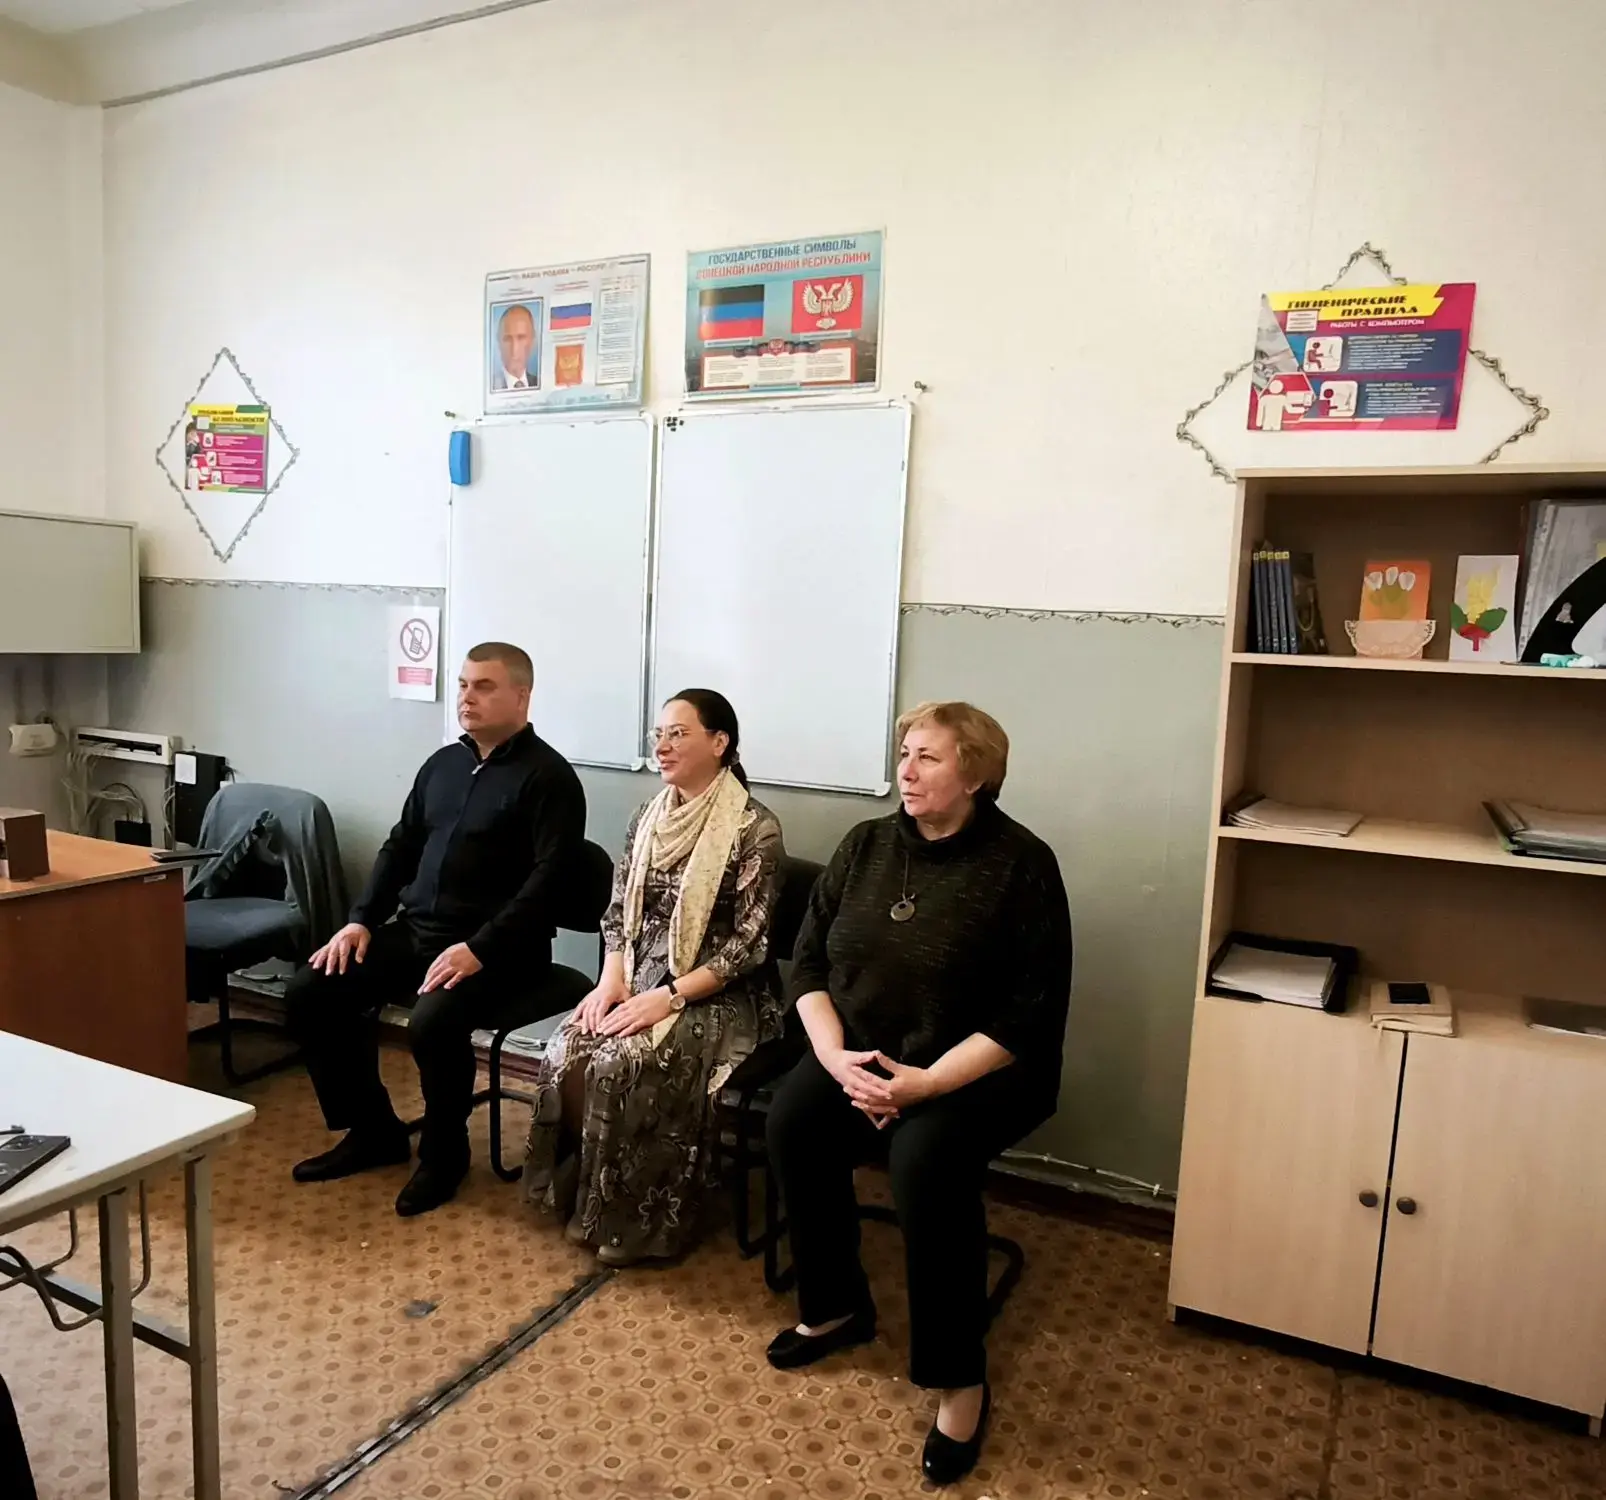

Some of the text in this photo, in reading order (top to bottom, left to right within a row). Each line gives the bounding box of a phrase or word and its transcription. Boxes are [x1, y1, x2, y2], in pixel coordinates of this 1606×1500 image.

[708, 238, 857, 266] ГОСУДАРСТВЕННЫЕ СИМВОЛЫ
[746, 258, 800, 276] НАРОДНОЙ
[803, 251, 871, 269] РЕСПУБЛИКИ
[1287, 294, 1407, 309] ГИГИЕНИЧЕСКИЕ
[1340, 306, 1418, 317] ПРАВИЛА
[1329, 321, 1358, 329] РАБОТЫ
[1367, 319, 1425, 327] КОМПЬЮТЕРОМ
